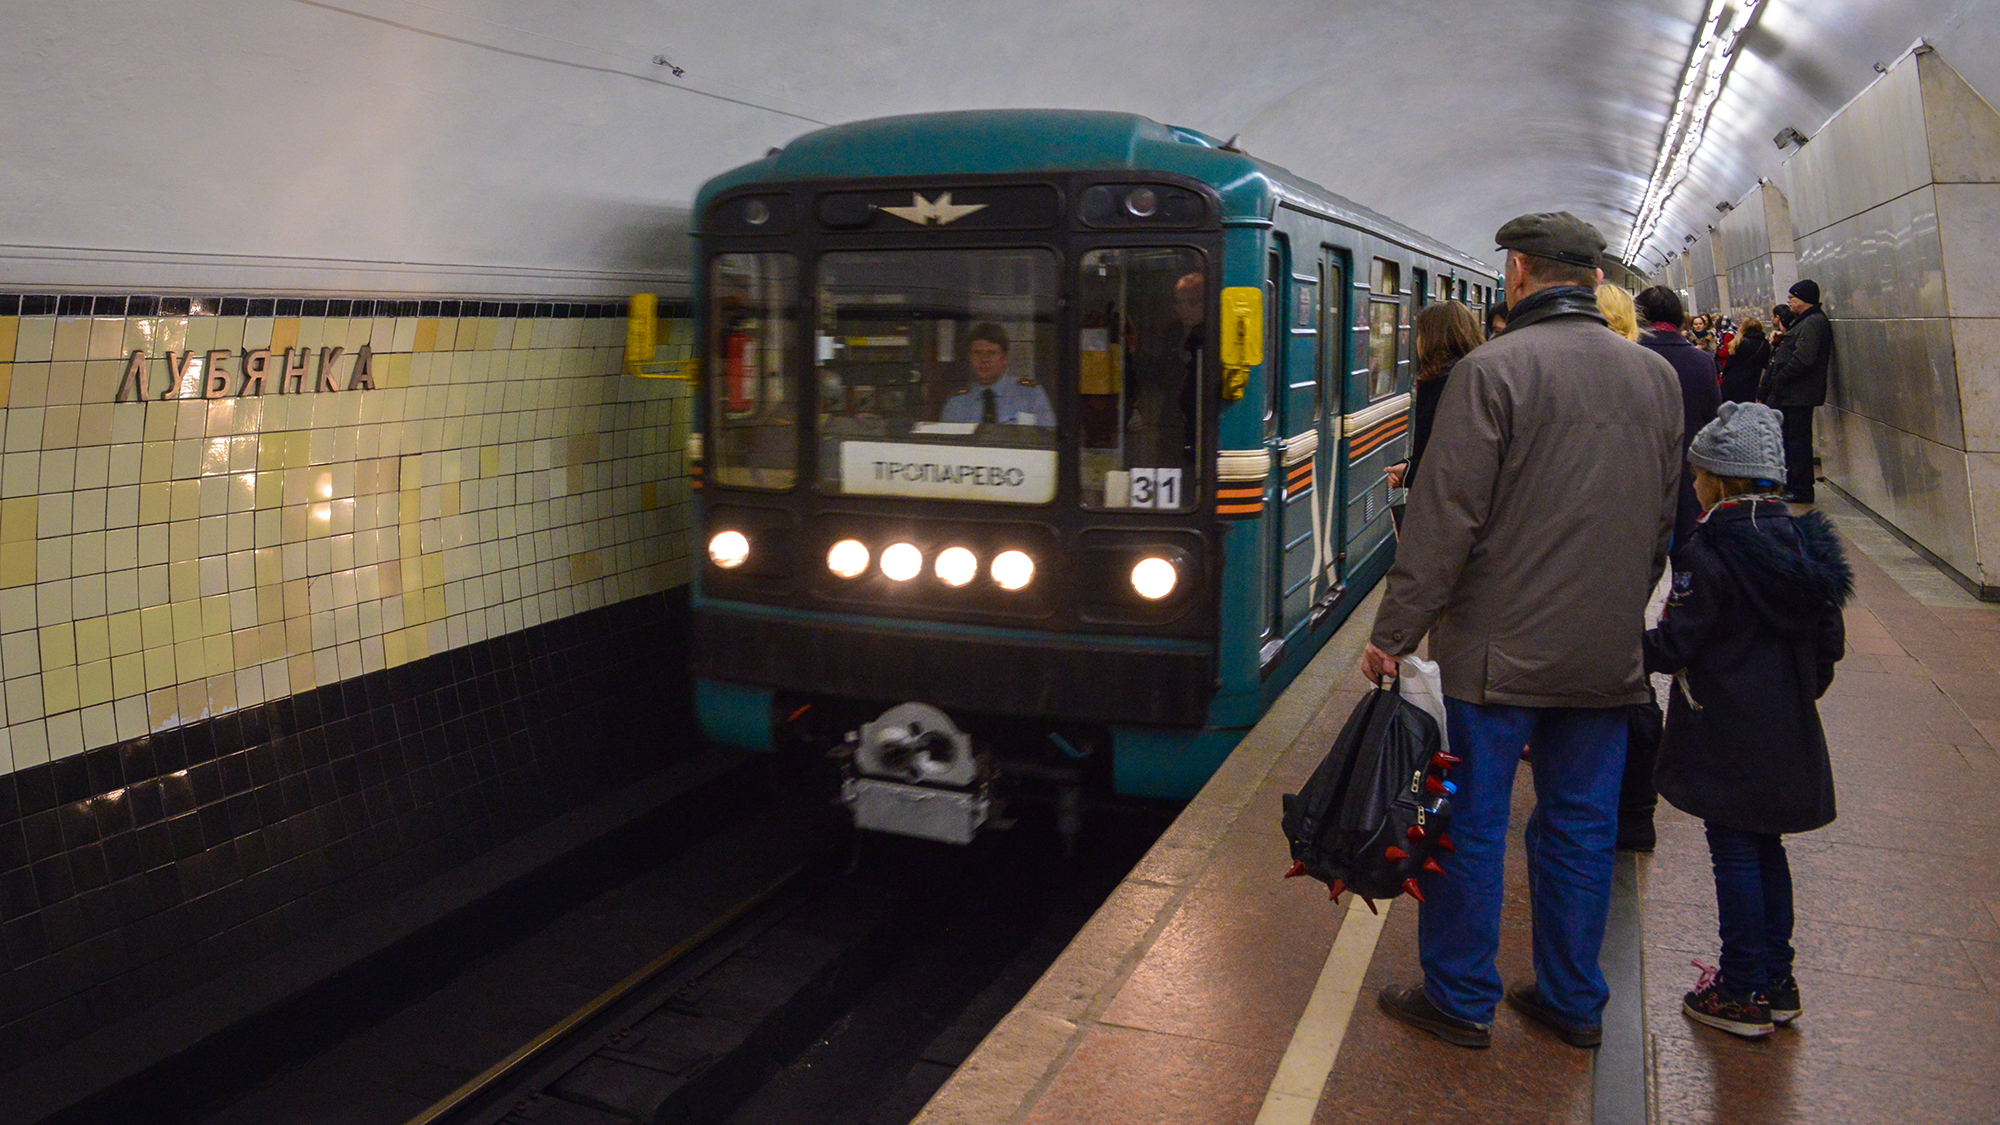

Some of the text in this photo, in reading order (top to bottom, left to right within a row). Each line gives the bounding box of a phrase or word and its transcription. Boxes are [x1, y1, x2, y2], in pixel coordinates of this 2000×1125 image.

[115, 344, 376, 402] ЛУБЯНКА
[872, 460, 1025, 488] ТРОПАРЕВО
[1131, 475, 1176, 504] 31
